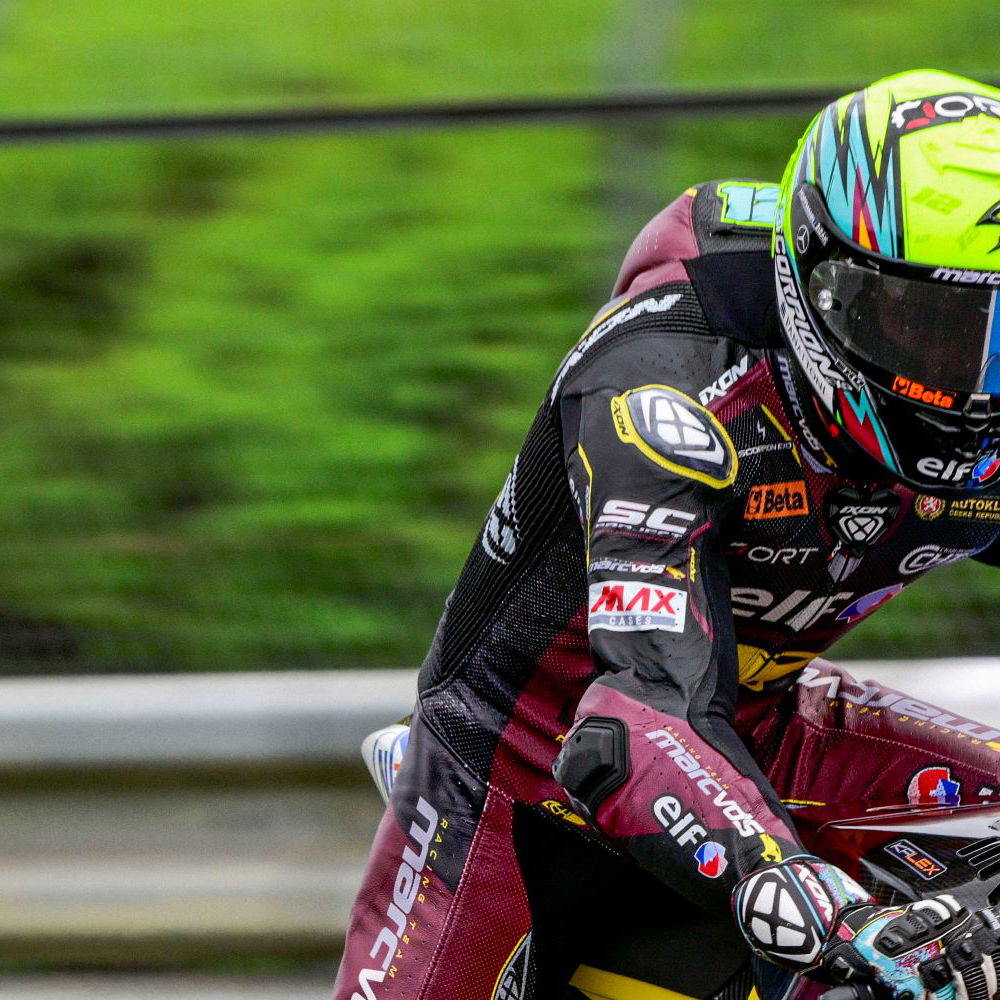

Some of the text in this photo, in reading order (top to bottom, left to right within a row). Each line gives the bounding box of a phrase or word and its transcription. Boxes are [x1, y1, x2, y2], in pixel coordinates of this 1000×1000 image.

[774, 206, 846, 382] SCORPION
[698, 354, 750, 406] IXON
[907, 383, 957, 409] Beta
[611, 399, 630, 437] IXON
[916, 456, 976, 482] elf
[597, 499, 697, 535] SC
[764, 492, 805, 514] Beta
[839, 504, 889, 515] IXON
[590, 584, 677, 616] MAX
[730, 586, 855, 633] elf
[608, 614, 653, 626] CASES
[665, 725, 730, 791] RACING TEAM
[653, 794, 708, 848] elf
[388, 817, 450, 979] RACING TEAM
